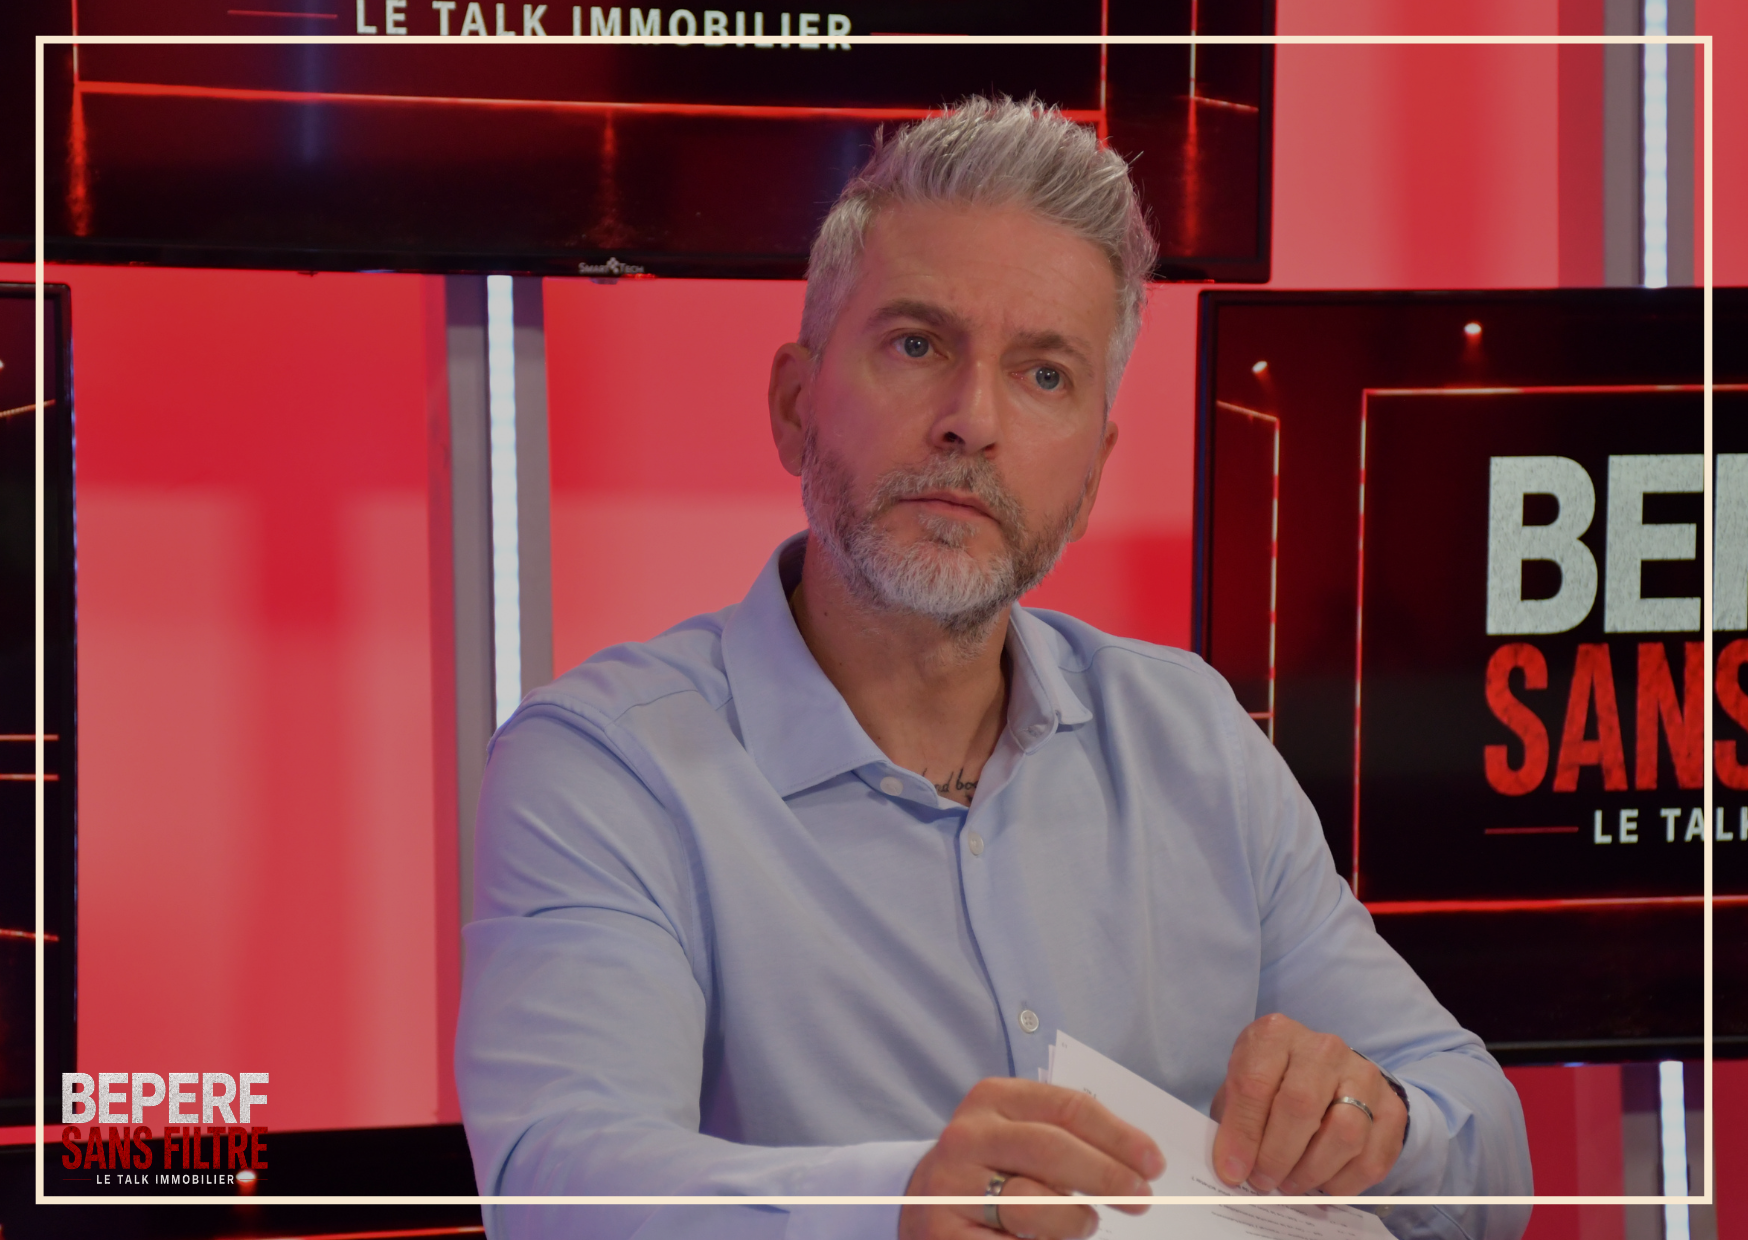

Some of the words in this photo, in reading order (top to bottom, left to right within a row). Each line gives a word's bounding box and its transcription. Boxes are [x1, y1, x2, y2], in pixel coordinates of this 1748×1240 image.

[356, 0, 408, 35] LE
[431, 0, 548, 37] TALK
[572, 5, 852, 50] IMMOBILIER
[1594, 808, 1639, 845] LE
